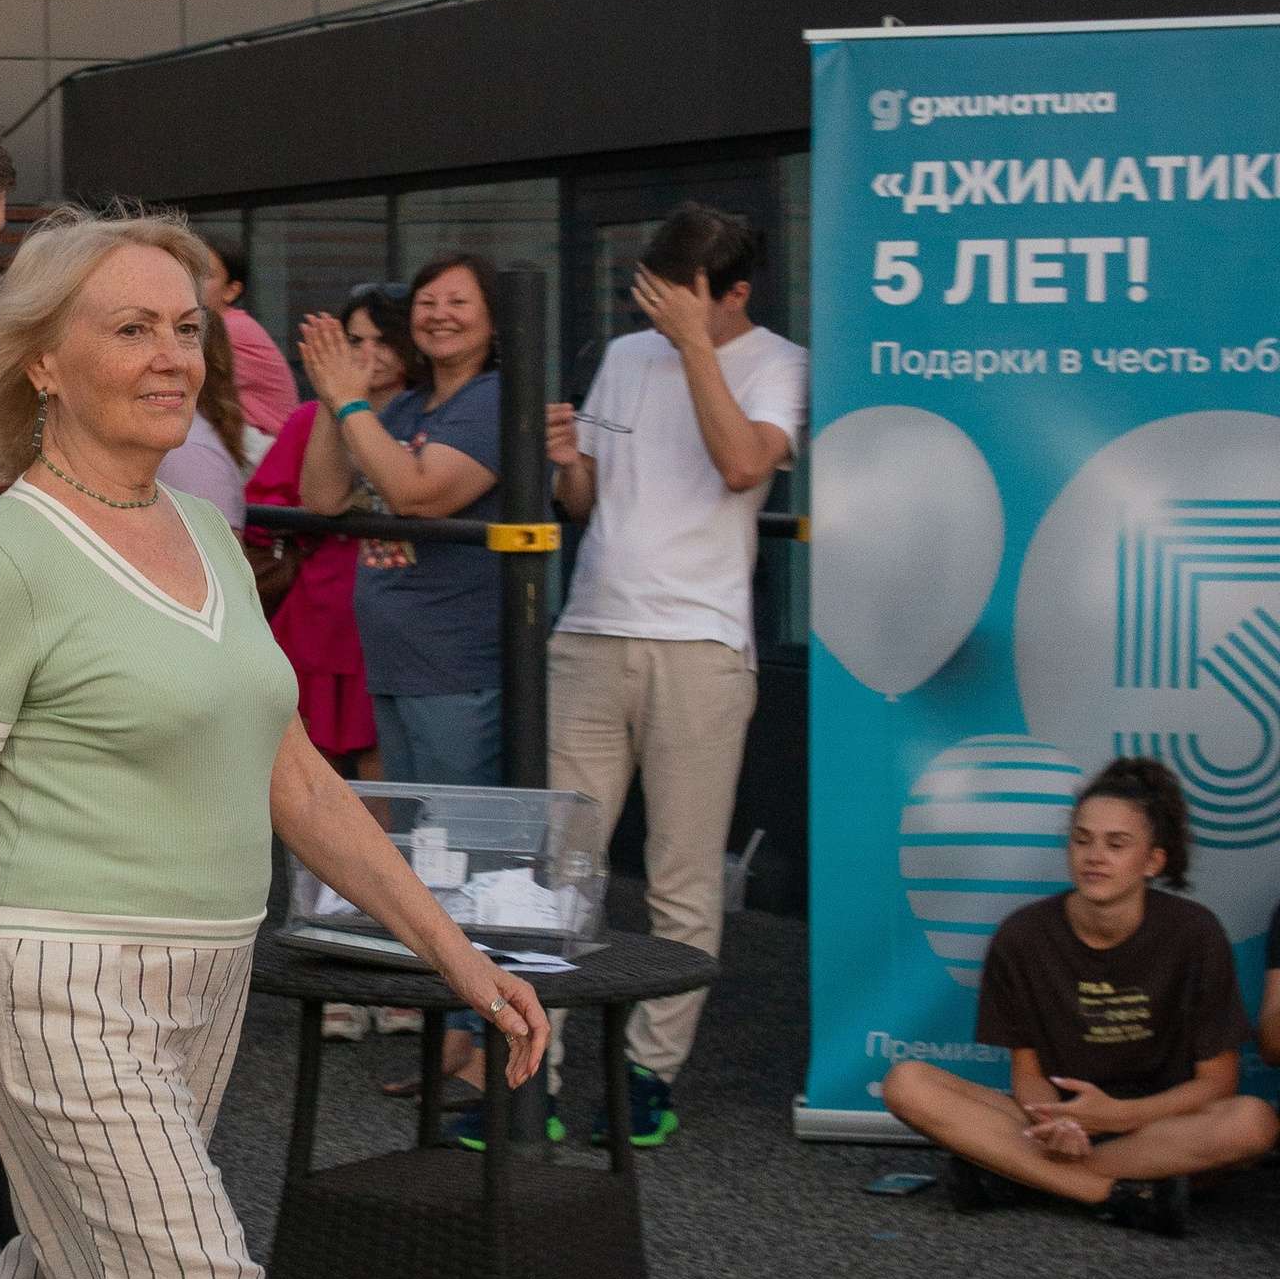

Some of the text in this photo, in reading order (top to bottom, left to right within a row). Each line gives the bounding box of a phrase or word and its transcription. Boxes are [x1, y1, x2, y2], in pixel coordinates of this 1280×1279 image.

[871, 153, 1280, 214] «ДЖИМАТИК
[872, 237, 1149, 305] 5 ЛЕТ!
[871, 341, 1048, 381] Подарки
[1059, 349, 1082, 374] в
[1093, 348, 1211, 374] честь
